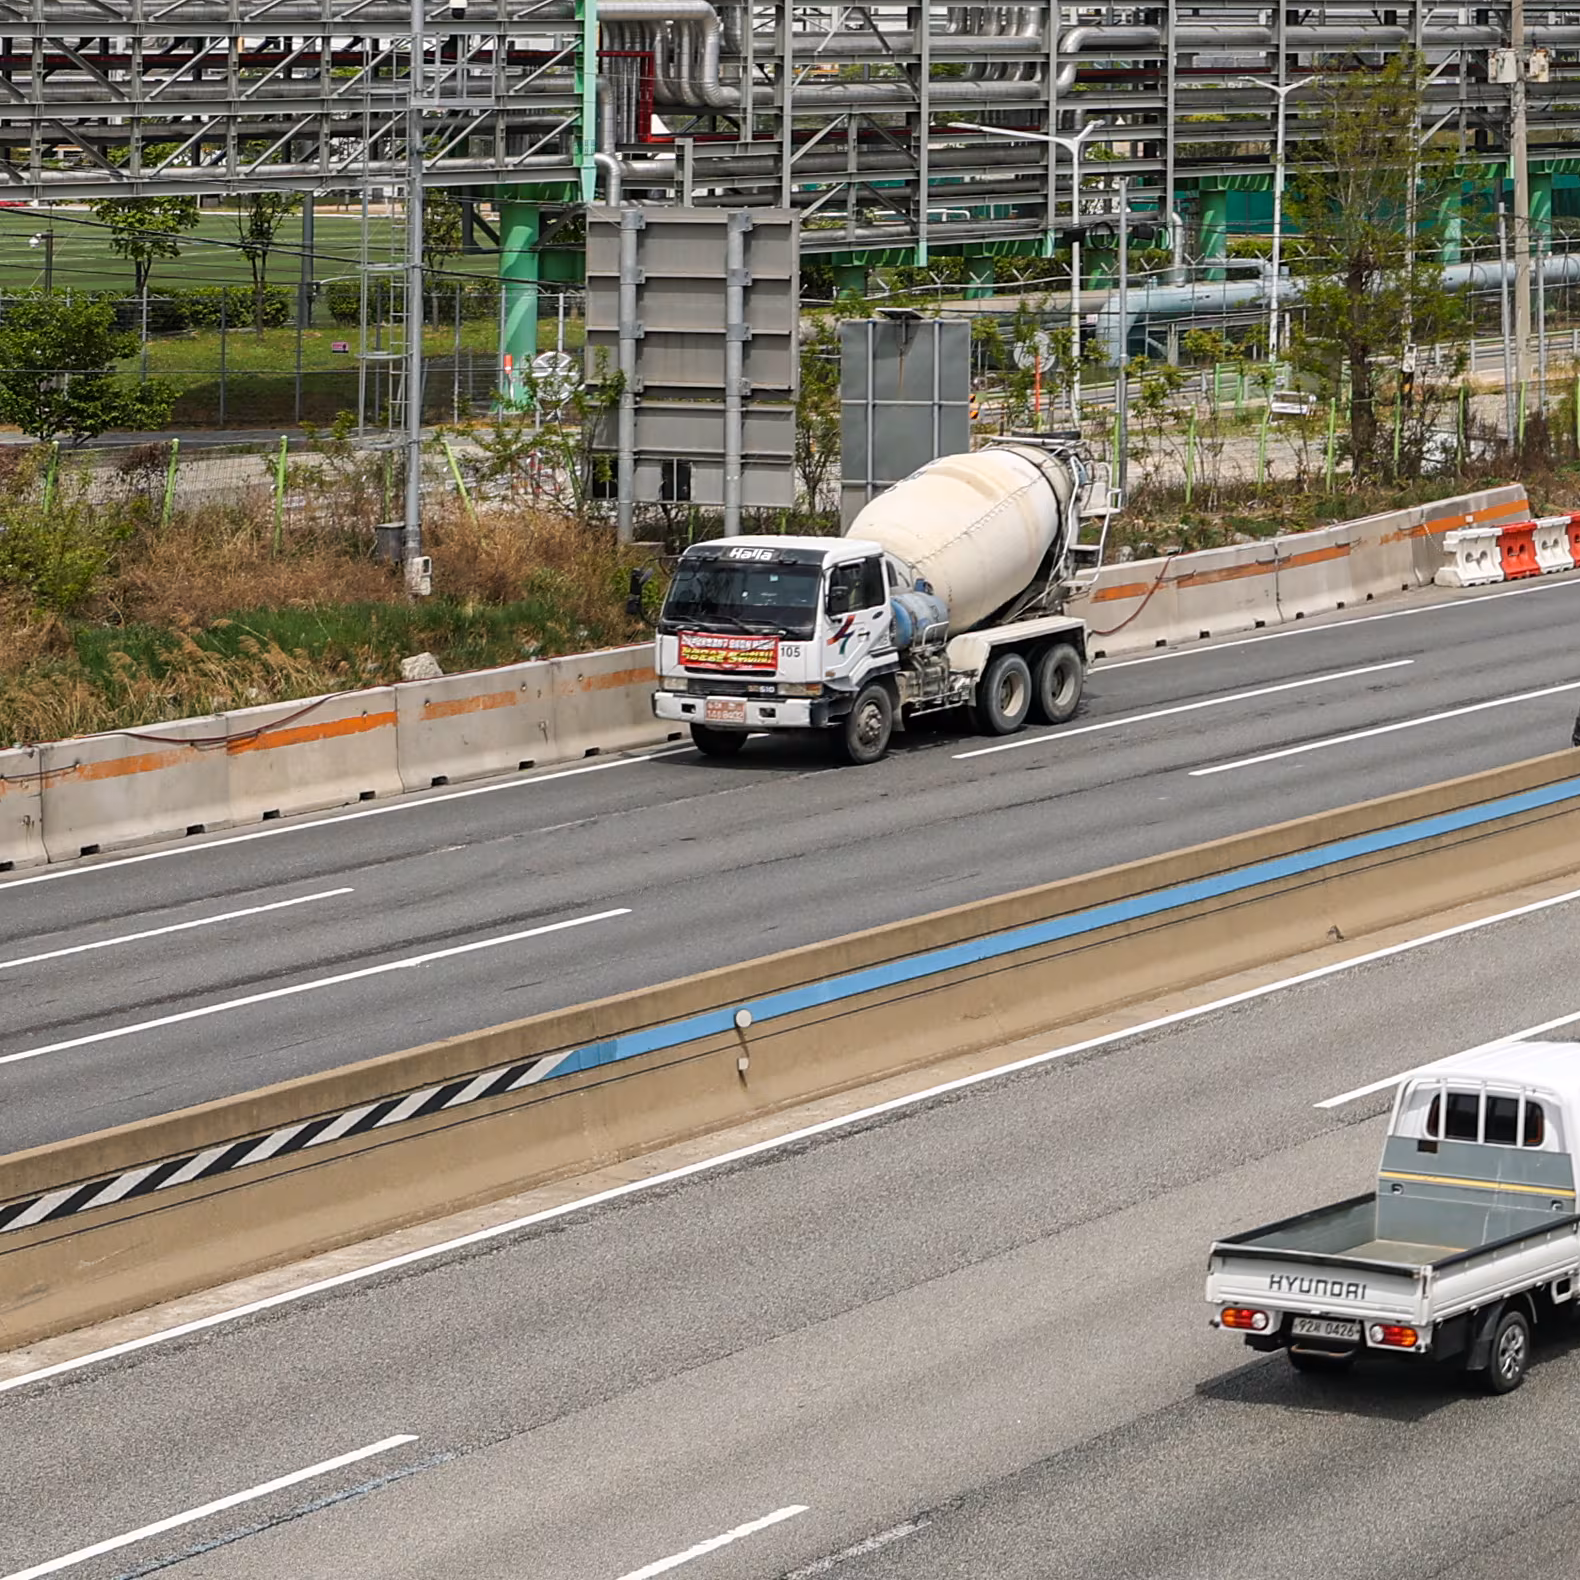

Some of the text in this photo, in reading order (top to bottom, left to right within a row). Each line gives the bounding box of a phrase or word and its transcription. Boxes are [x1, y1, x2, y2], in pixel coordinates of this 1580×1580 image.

[780, 646, 801, 658] 105
[1269, 1273, 1367, 1300] HYUNDAI
[1325, 1322, 1354, 1337] 0426
